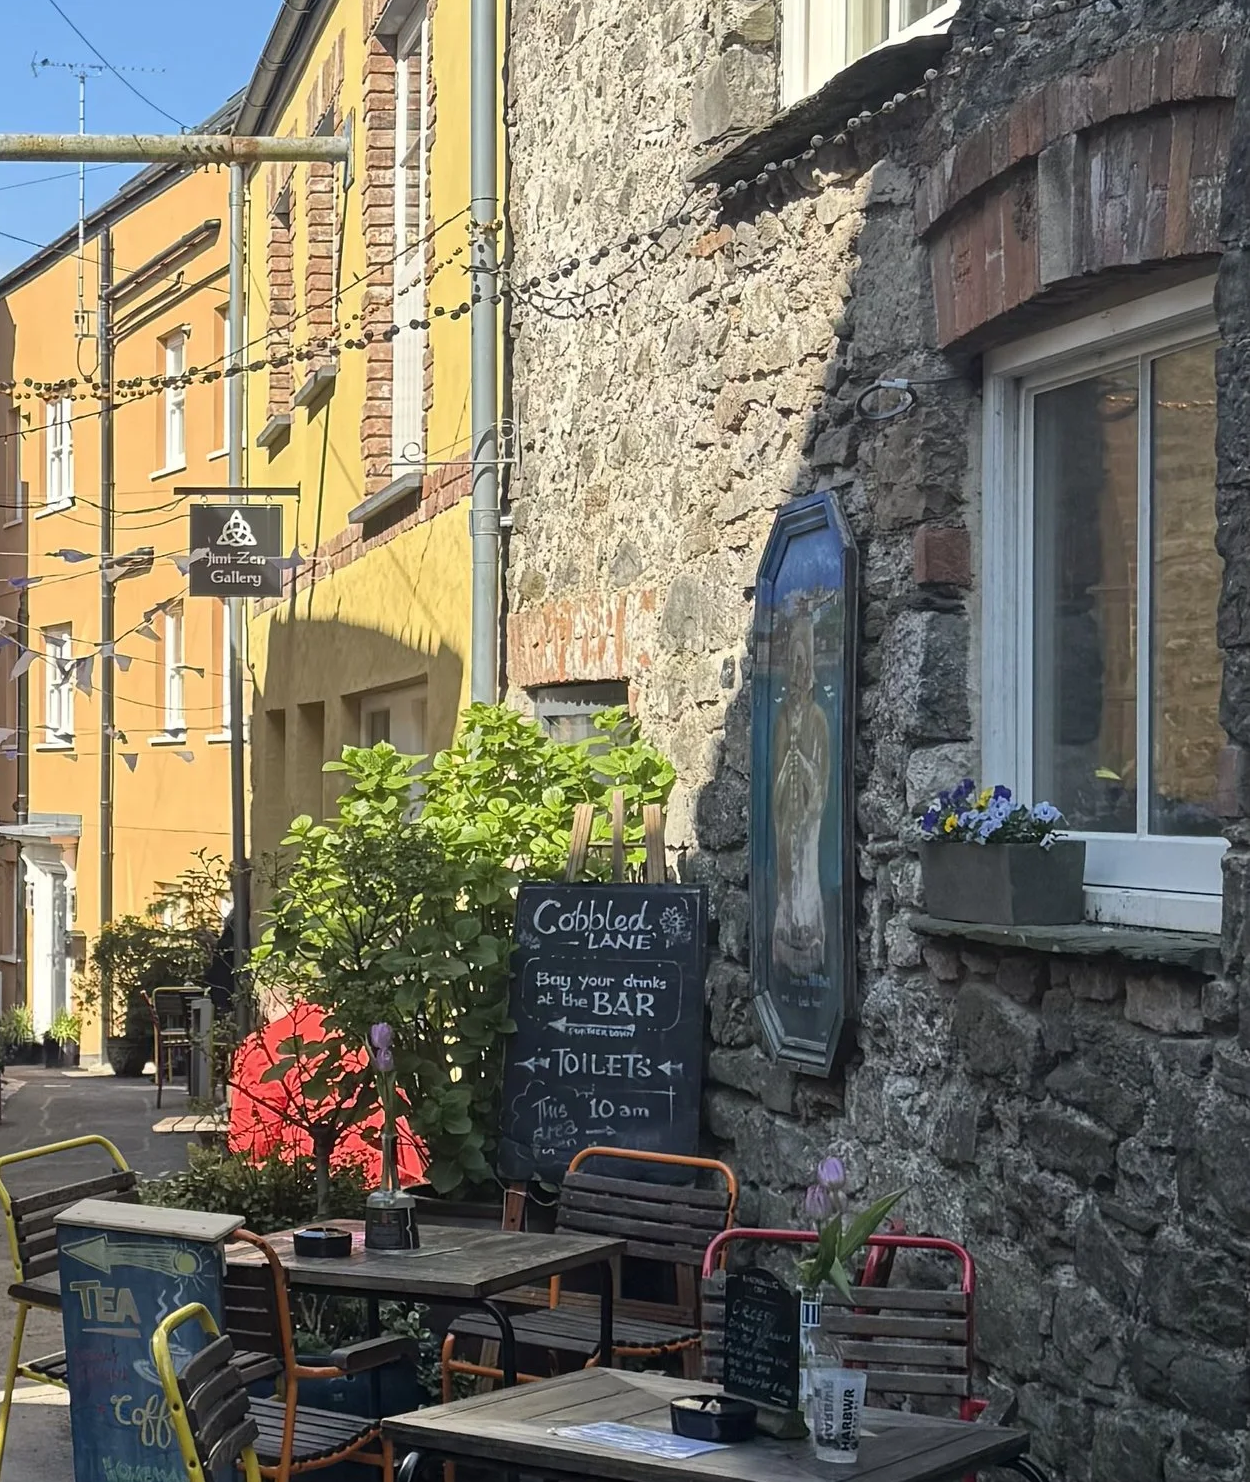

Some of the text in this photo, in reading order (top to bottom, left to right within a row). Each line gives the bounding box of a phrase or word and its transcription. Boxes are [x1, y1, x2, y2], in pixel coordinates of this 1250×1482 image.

[236, 551, 266, 565] Zen
[211, 569, 262, 587] Gallery
[533, 899, 654, 934] Cobbled
[578, 974, 615, 991] your
[623, 973, 667, 991] drinks
[537, 989, 655, 1017] at the BAR
[532, 1096, 649, 1120] This 10 am
[70, 1280, 141, 1324] TEA
[110, 1394, 174, 1449] Coff
[841, 1388, 855, 1451] HARBWR
